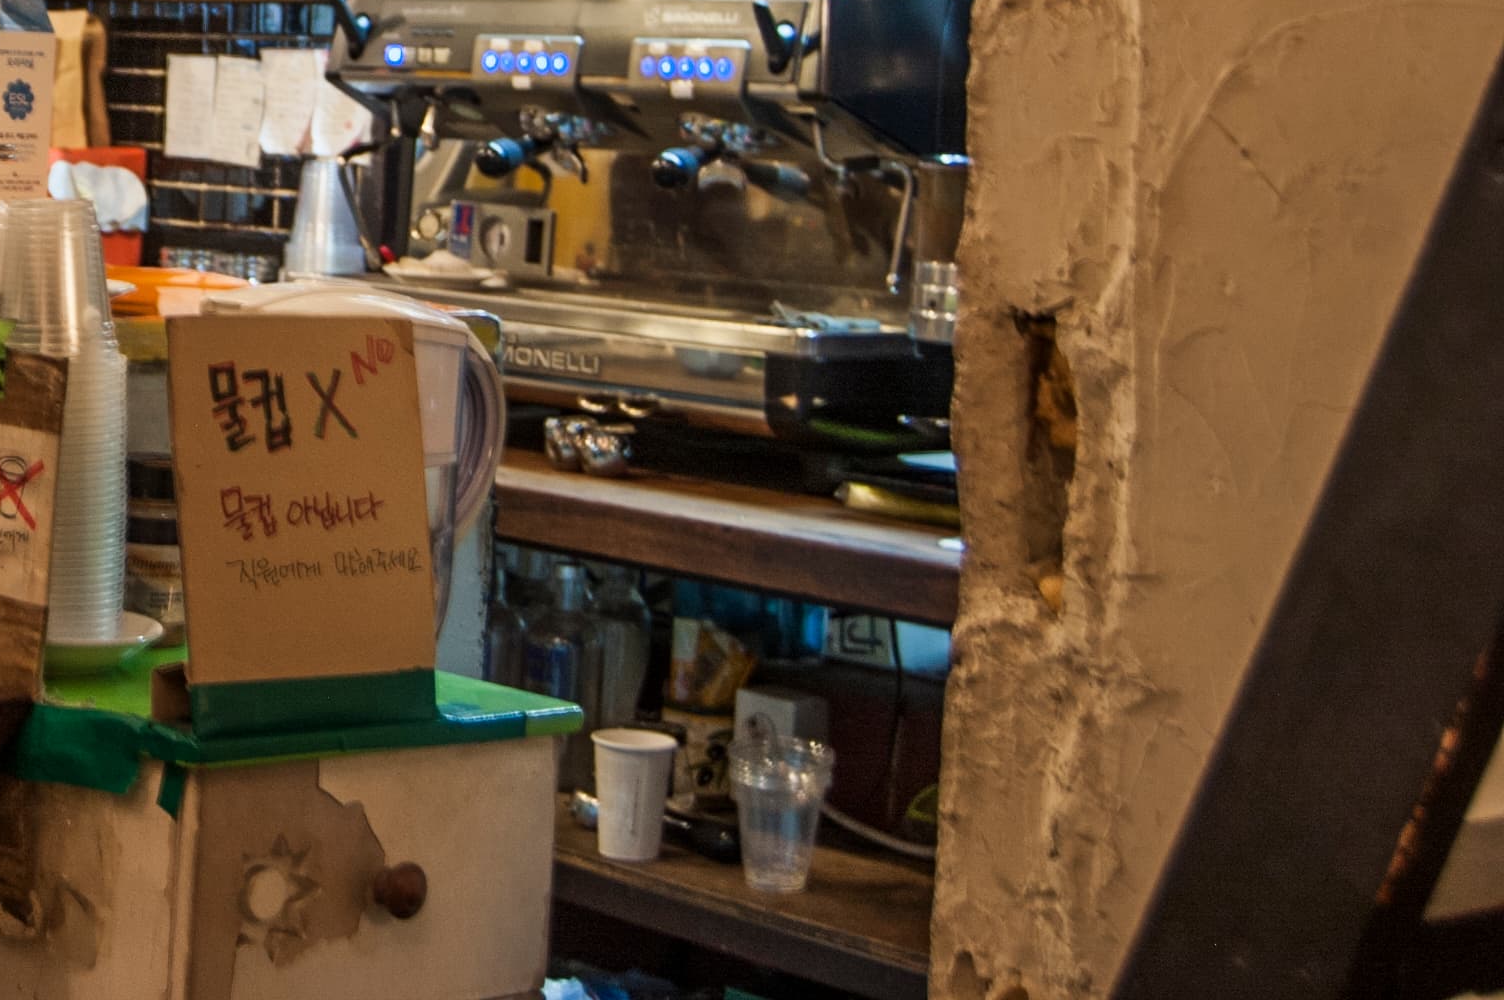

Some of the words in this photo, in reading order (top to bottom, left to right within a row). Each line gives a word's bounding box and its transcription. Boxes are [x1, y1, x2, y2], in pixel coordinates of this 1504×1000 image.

[208, 361, 293, 453] 물컵
[219, 485, 278, 542] 물컵
[285, 490, 386, 532] 아닙니다
[225, 557, 322, 591] 직원에게
